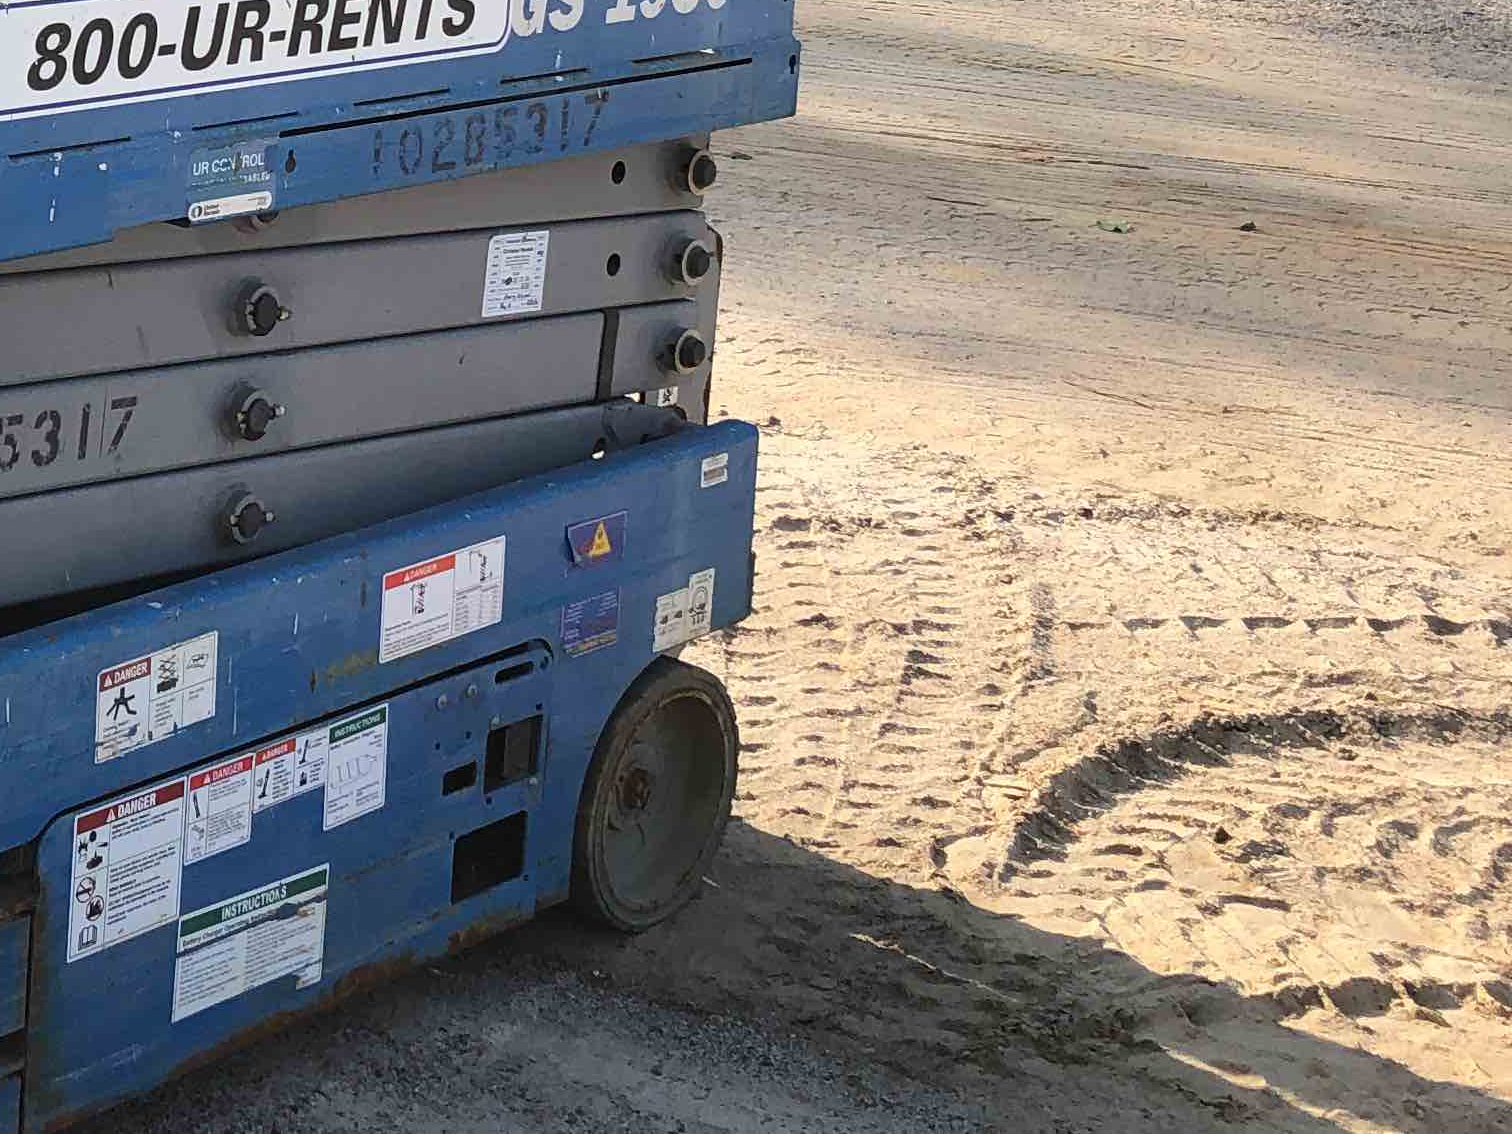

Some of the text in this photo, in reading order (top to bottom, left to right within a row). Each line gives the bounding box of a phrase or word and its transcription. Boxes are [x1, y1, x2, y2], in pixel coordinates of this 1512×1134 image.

[192, 161, 209, 176] UR
[113, 661, 148, 684] DANGER
[212, 761, 244, 780] DANGER
[117, 792, 157, 817] DANGER
[221, 885, 288, 921] INSTRUCTIONS
